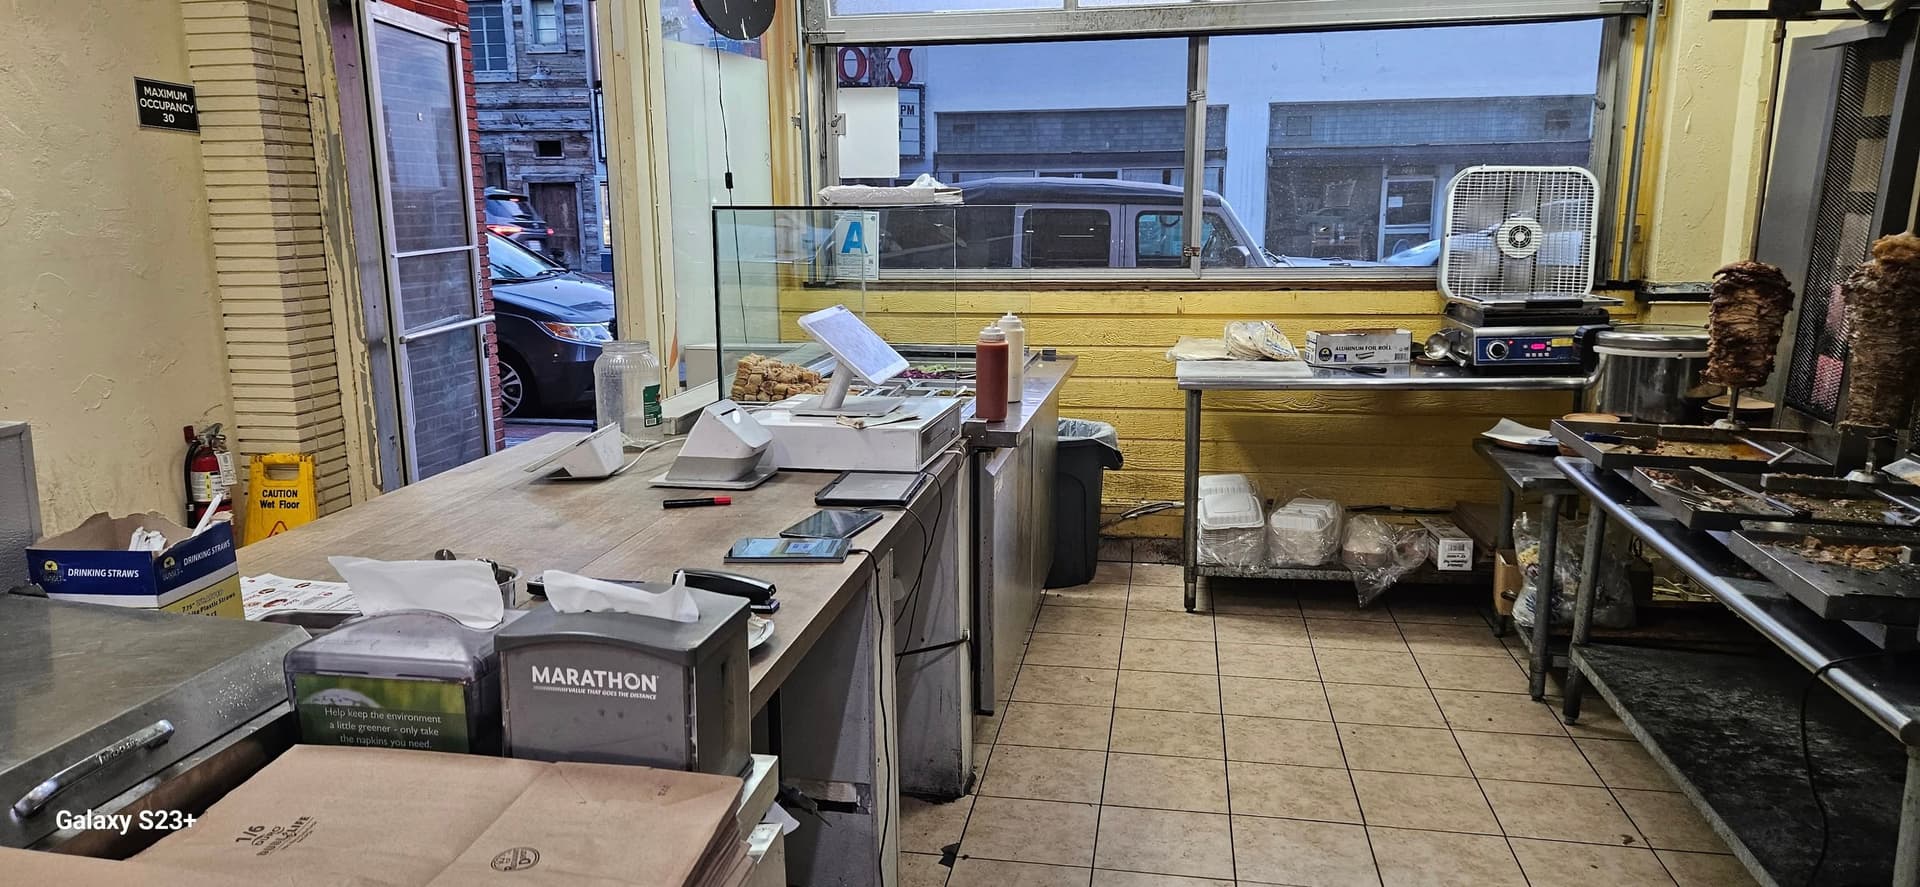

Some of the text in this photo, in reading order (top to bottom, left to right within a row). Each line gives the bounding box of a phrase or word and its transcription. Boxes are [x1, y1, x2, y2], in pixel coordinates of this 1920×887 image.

[144, 86, 187, 101] MAXIMUM
[140, 98, 193, 113] OCCUPANCY
[900, 104, 915, 116] PM
[162, 113, 175, 123] 30
[841, 221, 868, 254] A
[262, 489, 298, 498] CAUTION
[260, 499, 300, 509] Wet Floor
[183, 539, 231, 566] DRINKING STRAWS
[67, 568, 140, 578] DRINKING STRAWS
[532, 665, 657, 693] MARATHON
[568, 687, 586, 695] VALUE
[587, 688, 601, 696] THAT
[602, 689, 617, 697] GOES
[629, 692, 657, 700] DISTANCE
[325, 707, 442, 725] Help keep the environment
[336, 721, 357, 730] little
[358, 724, 391, 734] greener
[400, 730, 419, 742] only
[420, 731, 440, 742] take
[340, 733, 433, 750] the napkins you need.
[235, 825, 265, 843] 1/6
